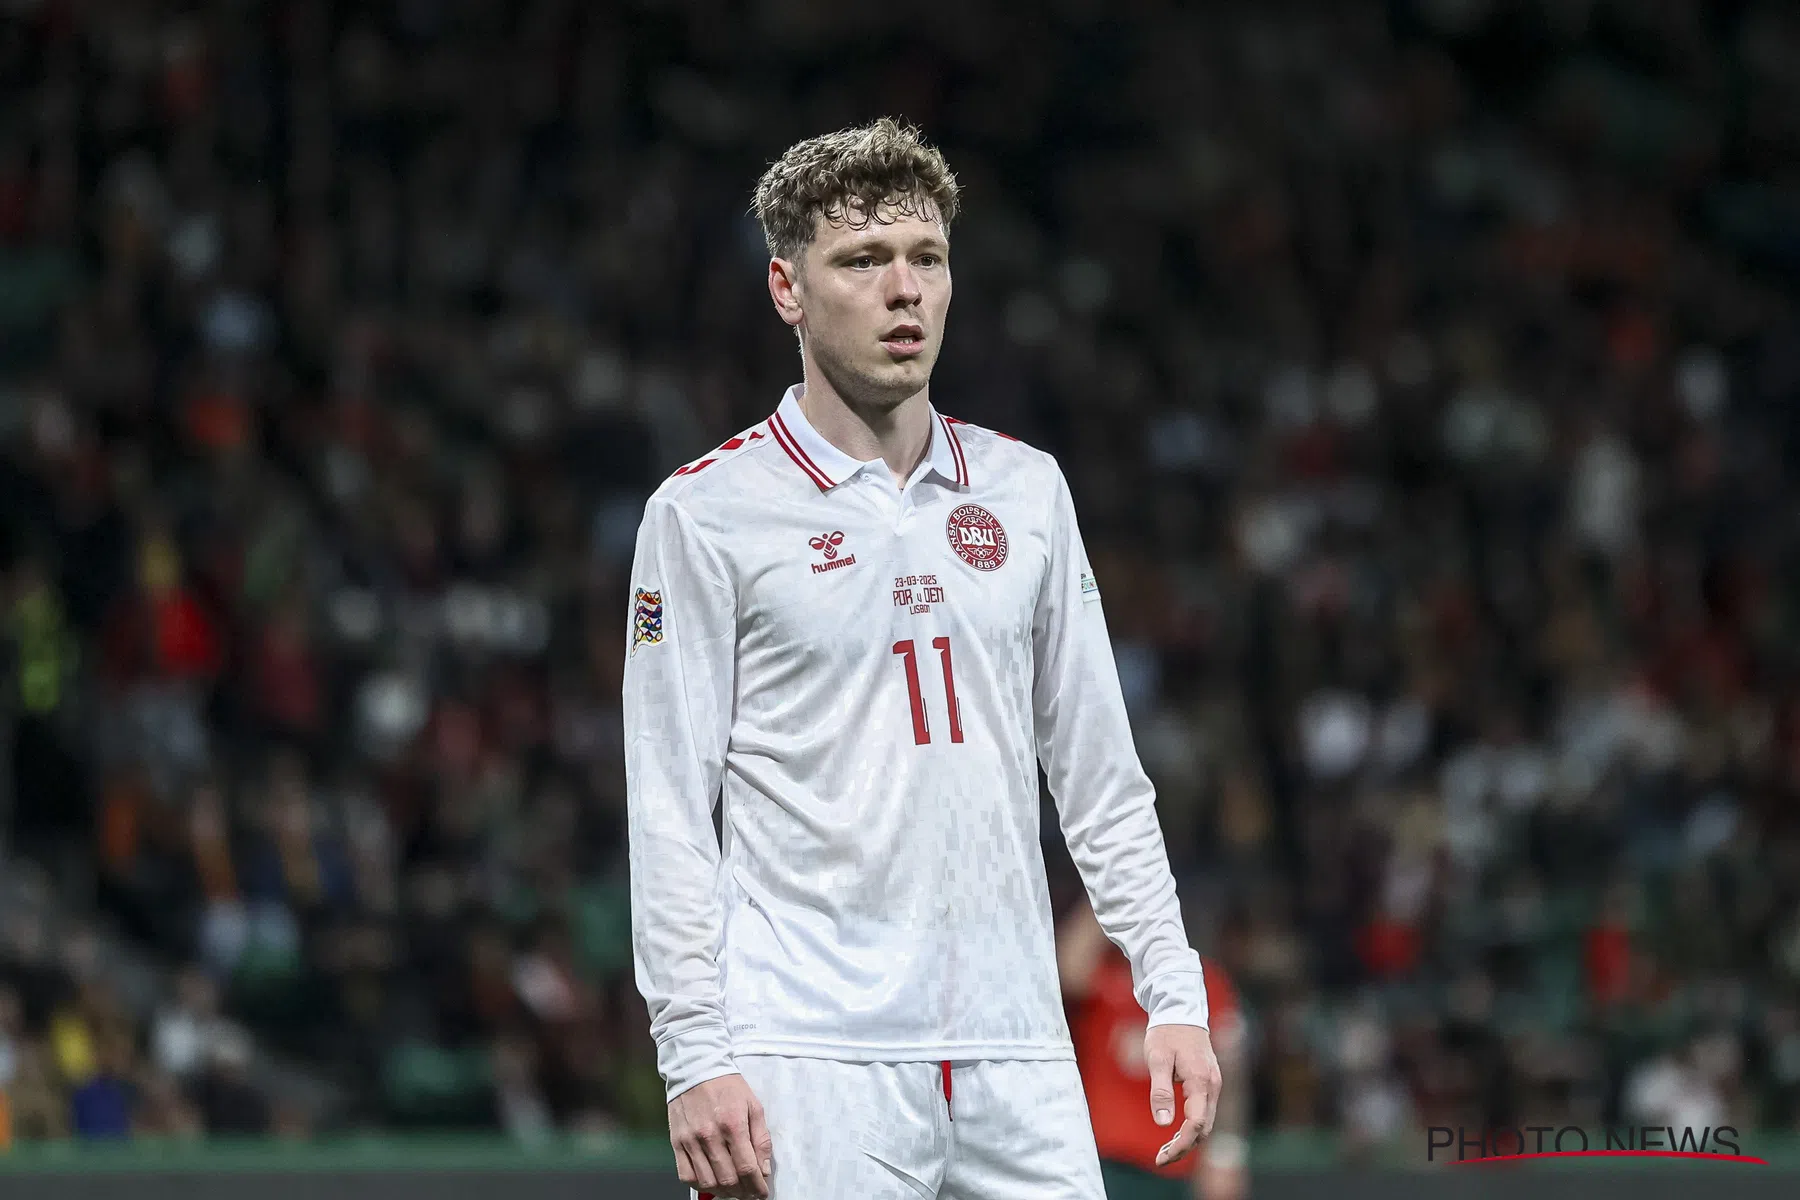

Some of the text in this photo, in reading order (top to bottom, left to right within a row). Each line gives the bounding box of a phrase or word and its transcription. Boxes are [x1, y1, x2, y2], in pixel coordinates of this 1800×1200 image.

[948, 522, 968, 561] DANSK
[996, 527, 1006, 562] UNION
[958, 526, 997, 546] DBU
[811, 553, 856, 574] hummel
[972, 559, 996, 569] 1889
[894, 574, 937, 588] 23-03-2025
[892, 588, 913, 607] POR
[923, 586, 945, 603] DEN
[909, 604, 931, 615] LISBON
[892, 636, 964, 745] 11
